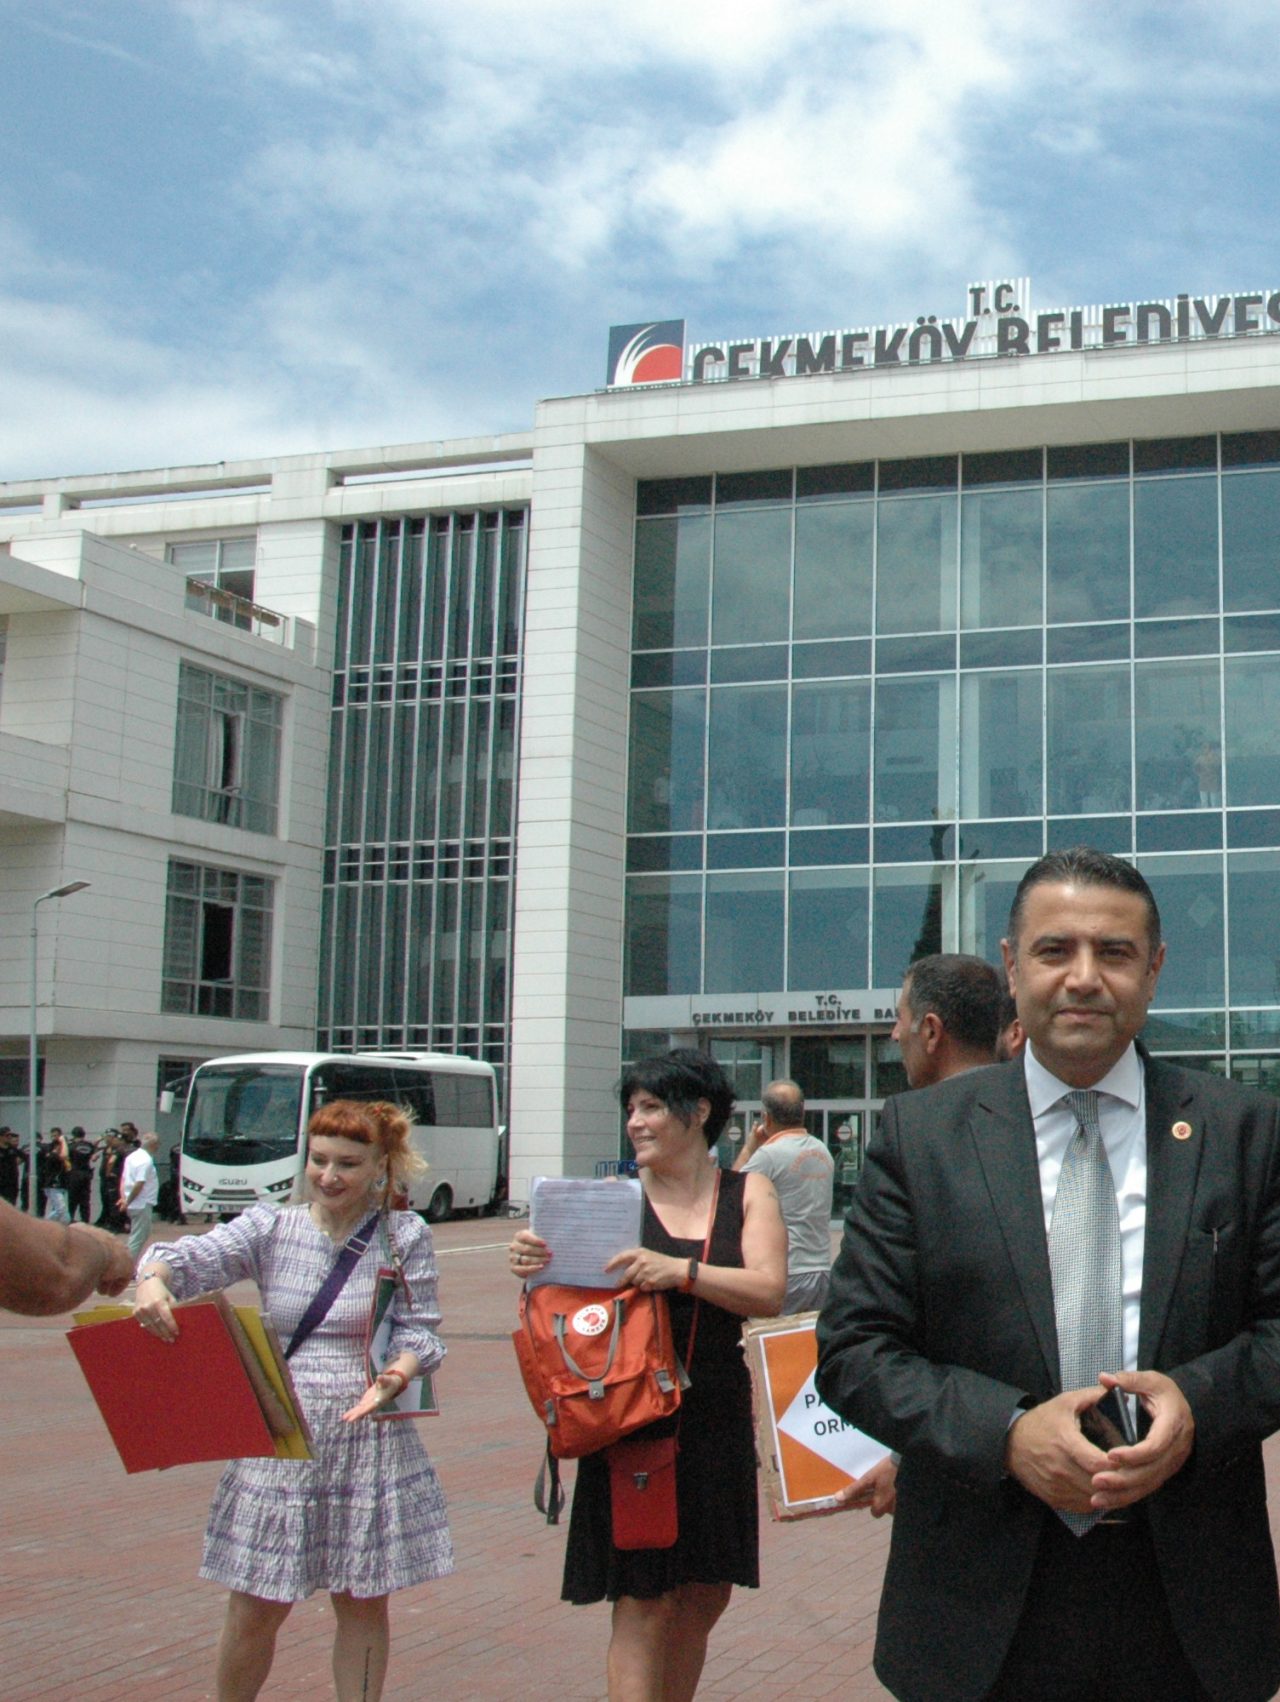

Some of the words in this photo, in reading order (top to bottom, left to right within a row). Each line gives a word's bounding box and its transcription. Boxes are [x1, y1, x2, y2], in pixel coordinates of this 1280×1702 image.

[968, 283, 1020, 316] T.C.
[815, 995, 841, 1006] T.C.
[692, 1008, 774, 1026] ÇEKMEKÖY
[788, 1007, 861, 1022] BELEDİYE
